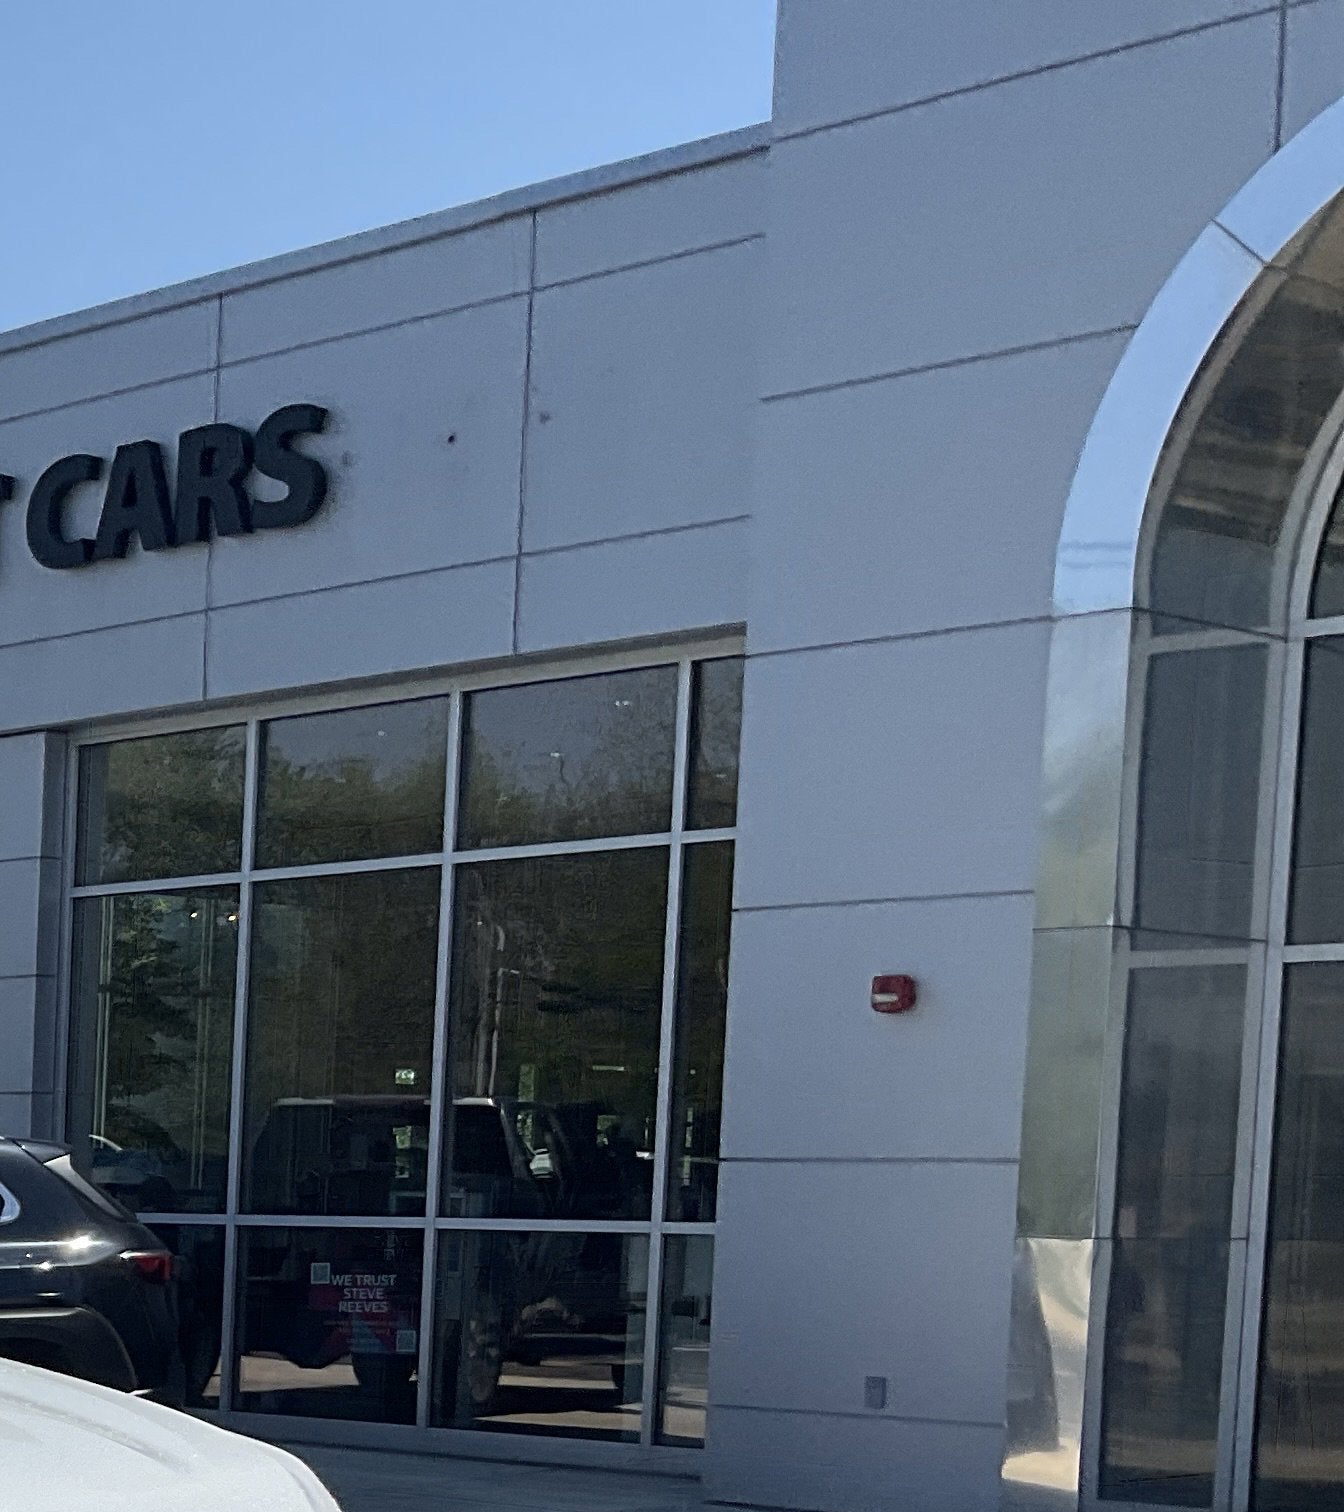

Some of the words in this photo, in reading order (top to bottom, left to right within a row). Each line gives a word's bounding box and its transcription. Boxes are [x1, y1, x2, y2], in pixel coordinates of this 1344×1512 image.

[25, 403, 328, 569] CARS
[331, 1275, 353, 1286] WE
[356, 1274, 398, 1286] TRUST
[343, 1287, 385, 1300] STEVE
[338, 1300, 389, 1313] REEVES
